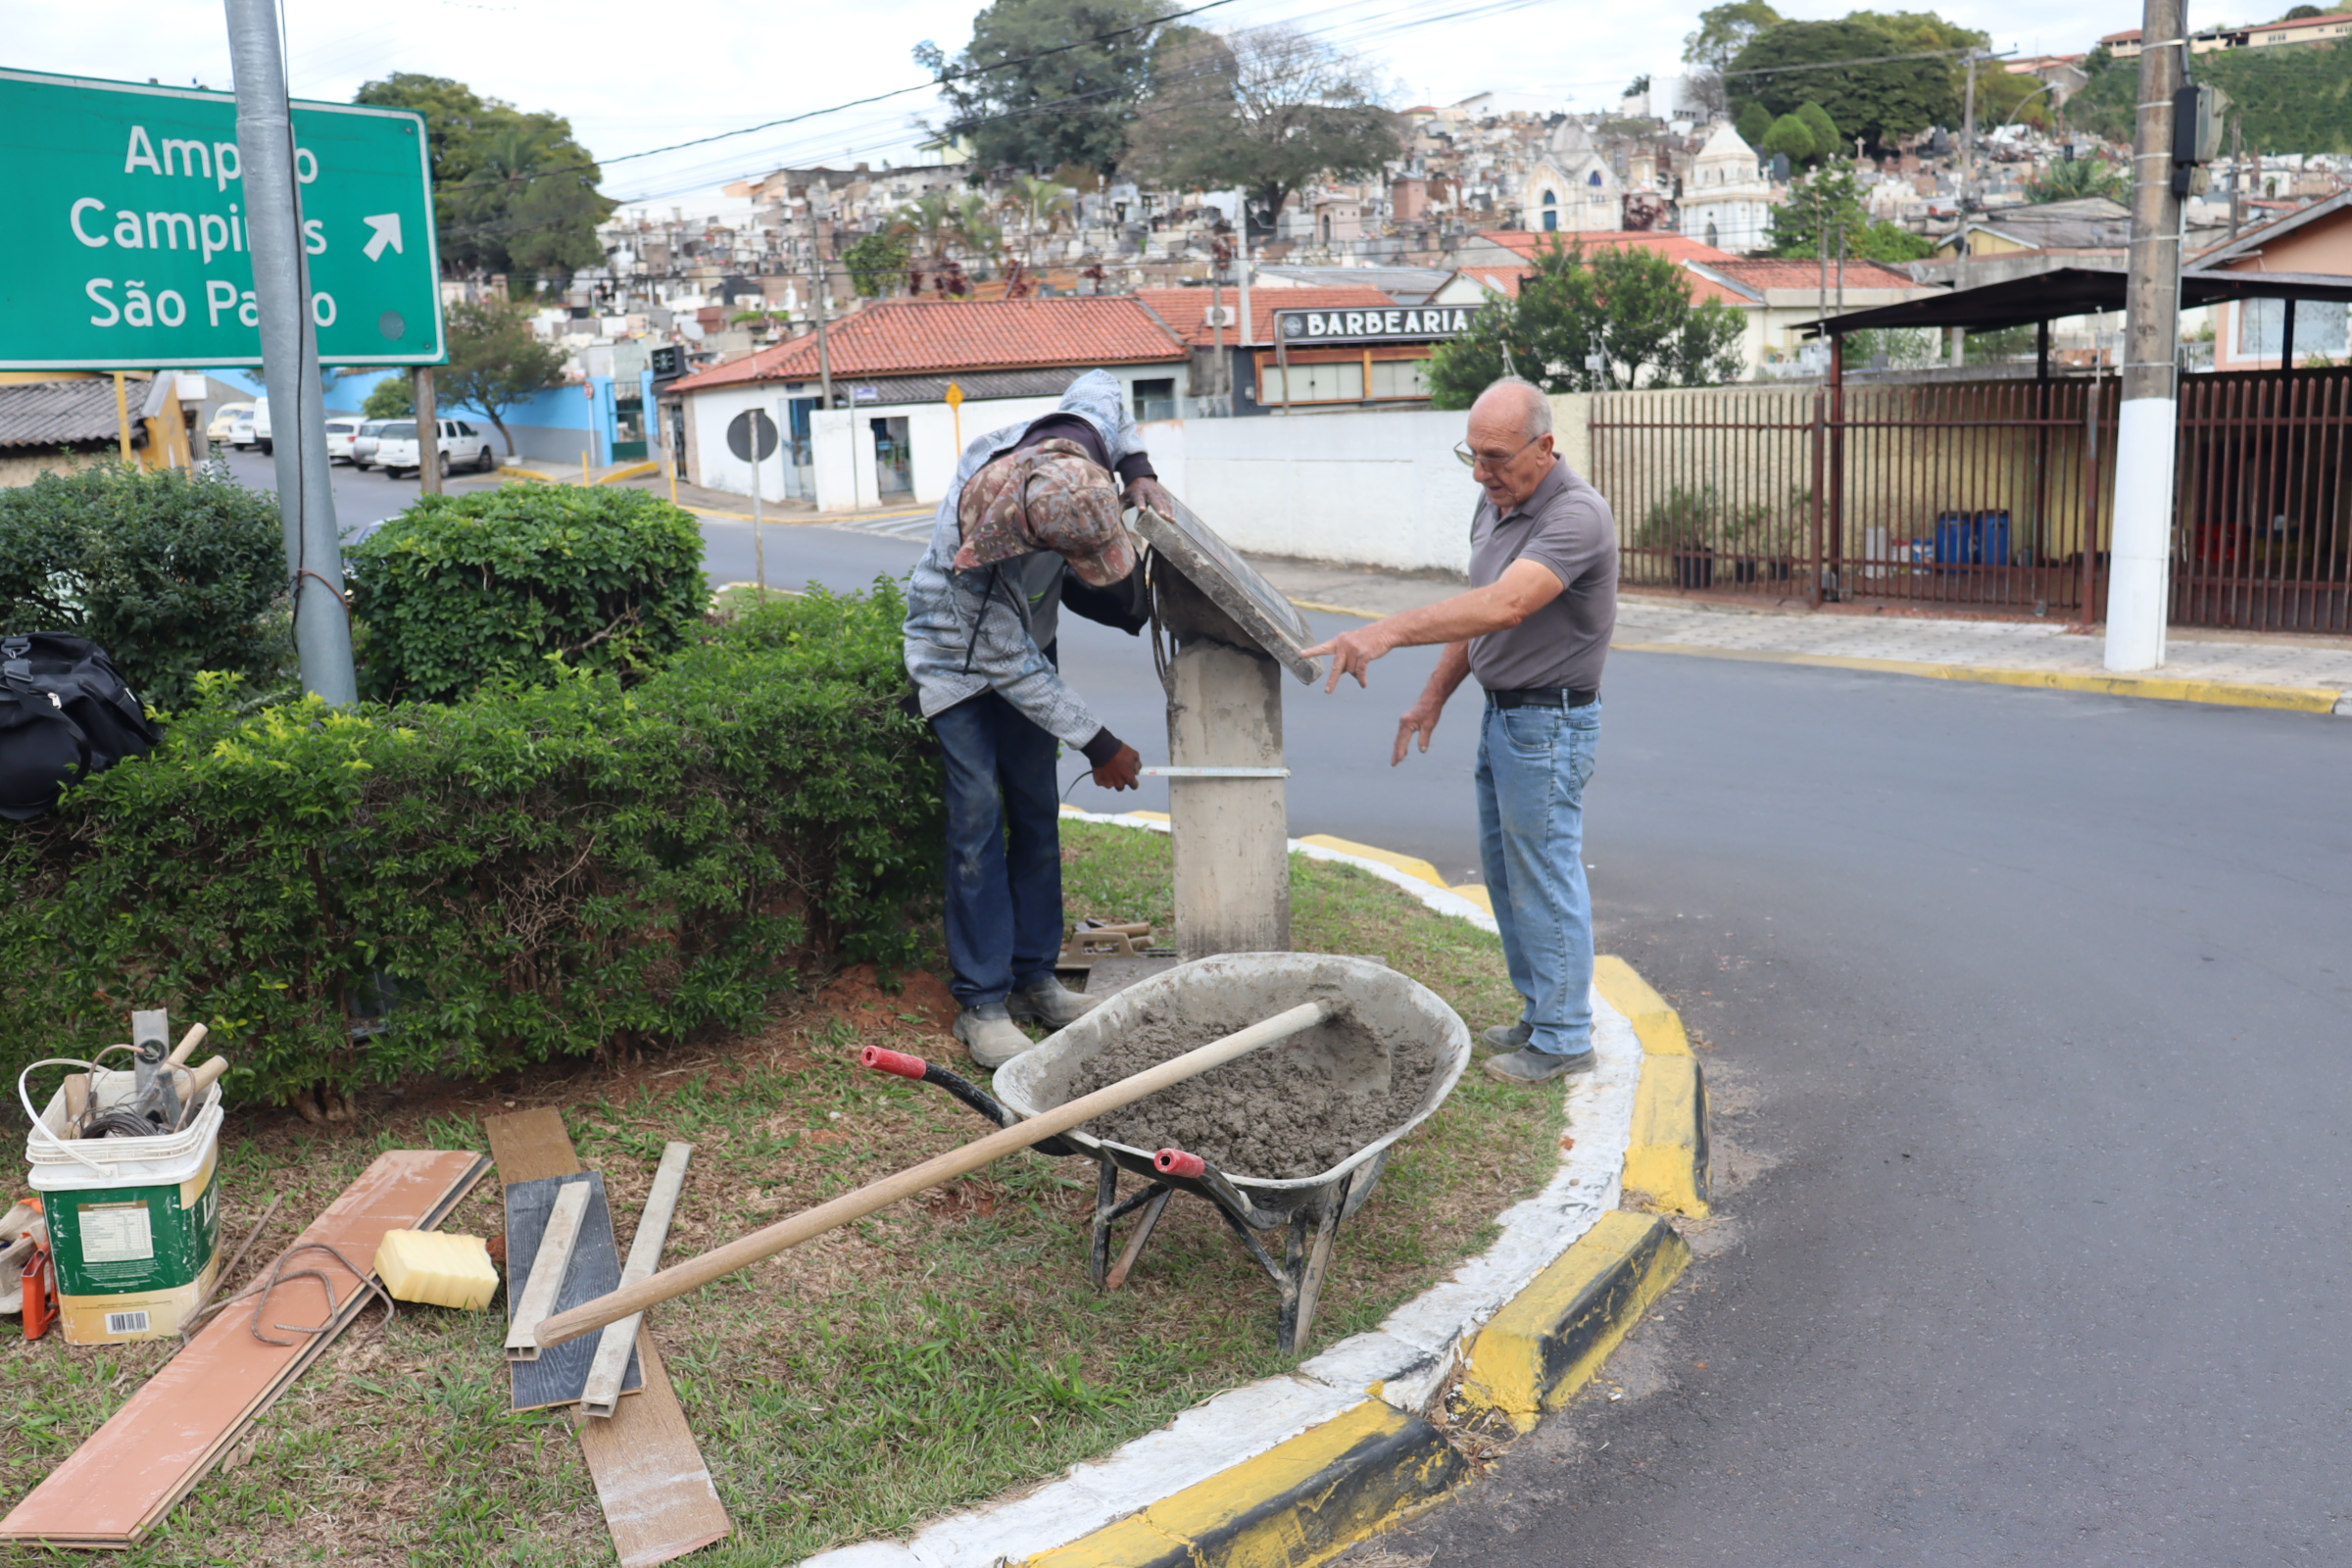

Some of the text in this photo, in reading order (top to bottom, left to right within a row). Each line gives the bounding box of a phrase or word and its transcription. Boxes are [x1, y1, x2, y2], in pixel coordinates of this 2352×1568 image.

[124, 124, 319, 193] Ampo
[70, 197, 328, 265] Campis
[84, 277, 337, 328] São Pao
[1307, 310, 1469, 337] BARBEARIA
